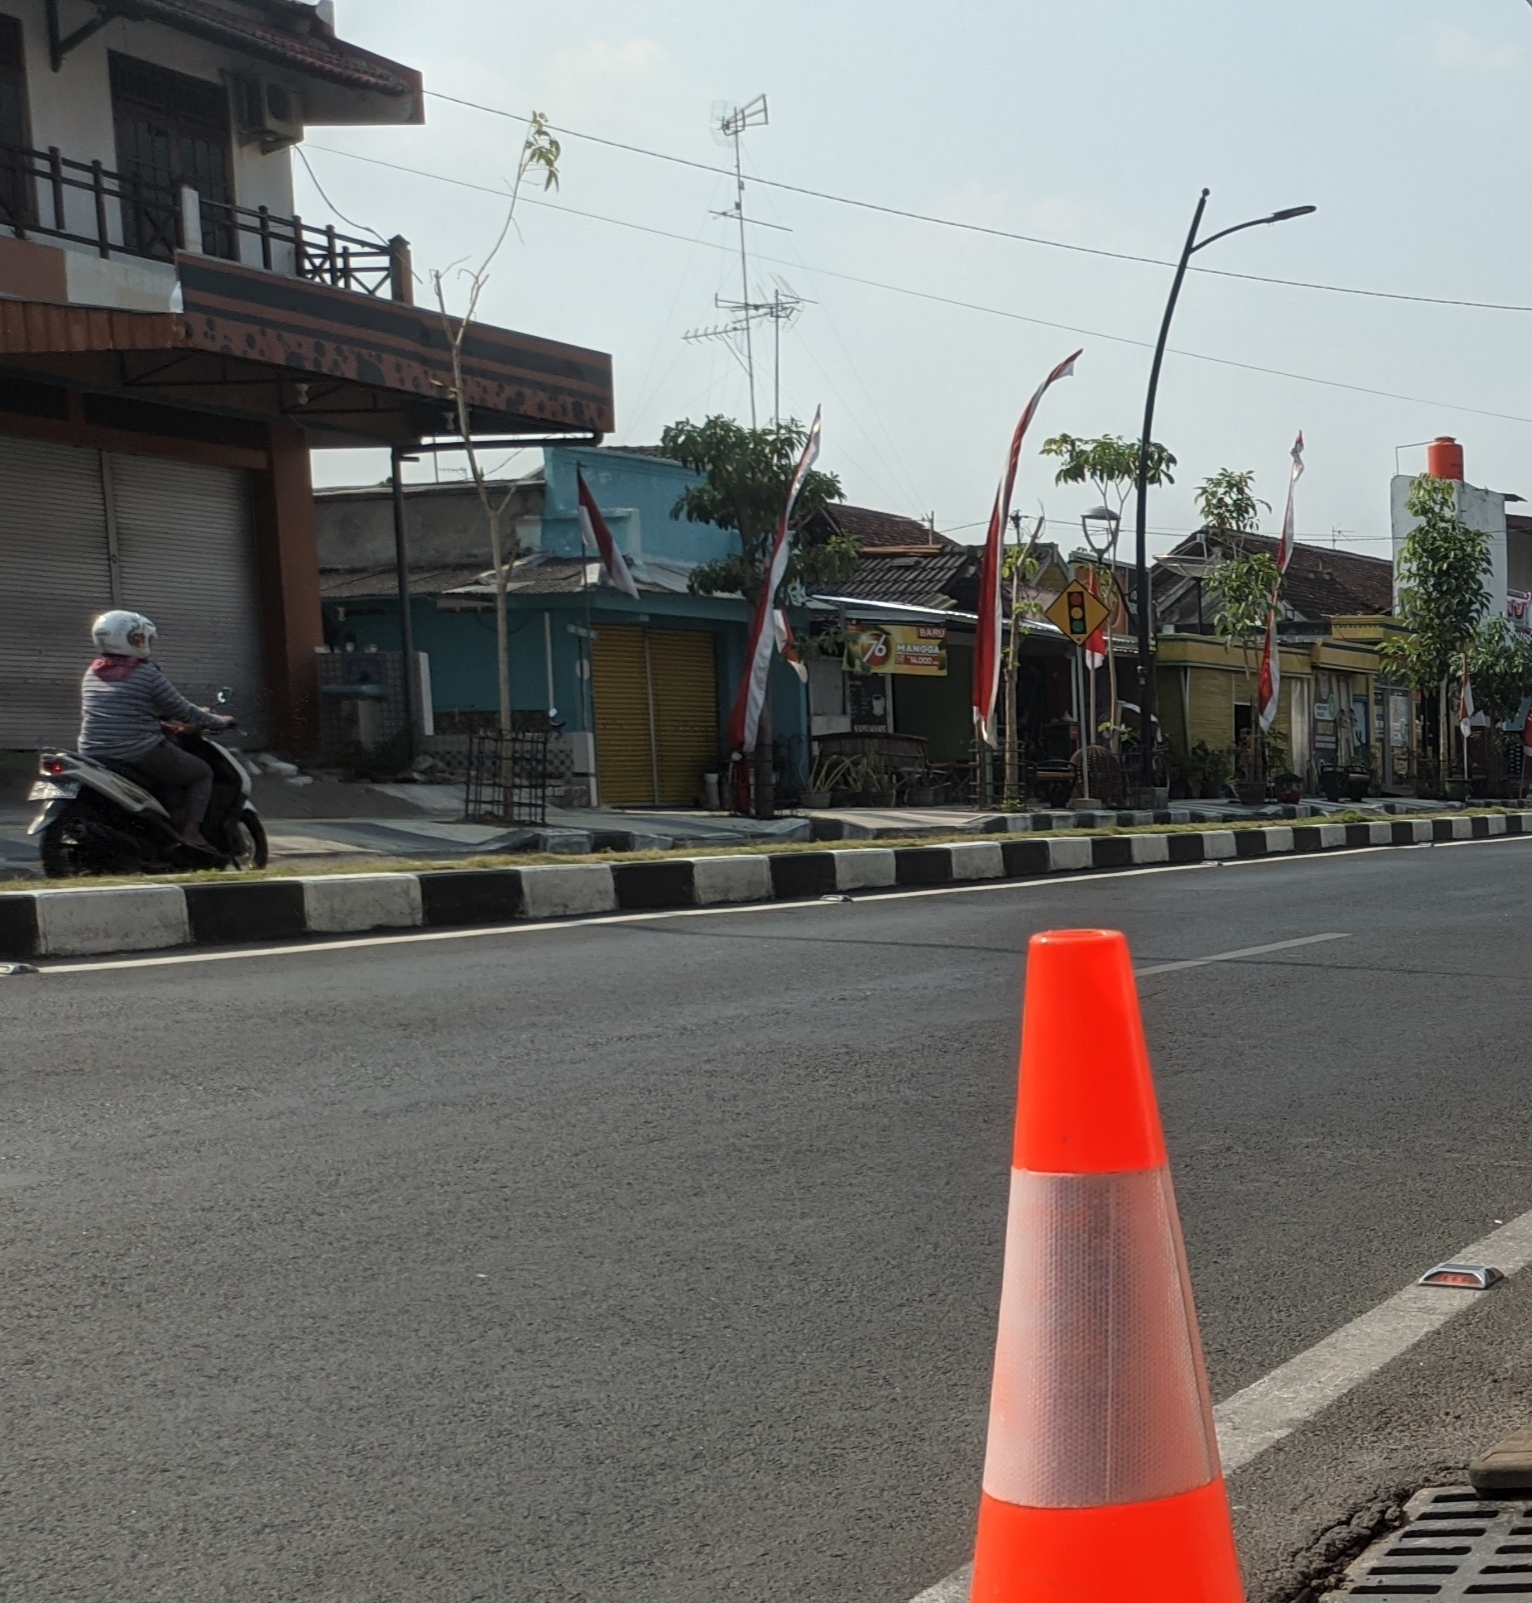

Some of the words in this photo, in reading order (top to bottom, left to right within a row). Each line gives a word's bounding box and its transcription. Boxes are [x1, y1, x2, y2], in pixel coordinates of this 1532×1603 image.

[920, 628, 945, 638] BARU
[862, 634, 887, 663] 76
[896, 644, 940, 654] MANGGA
